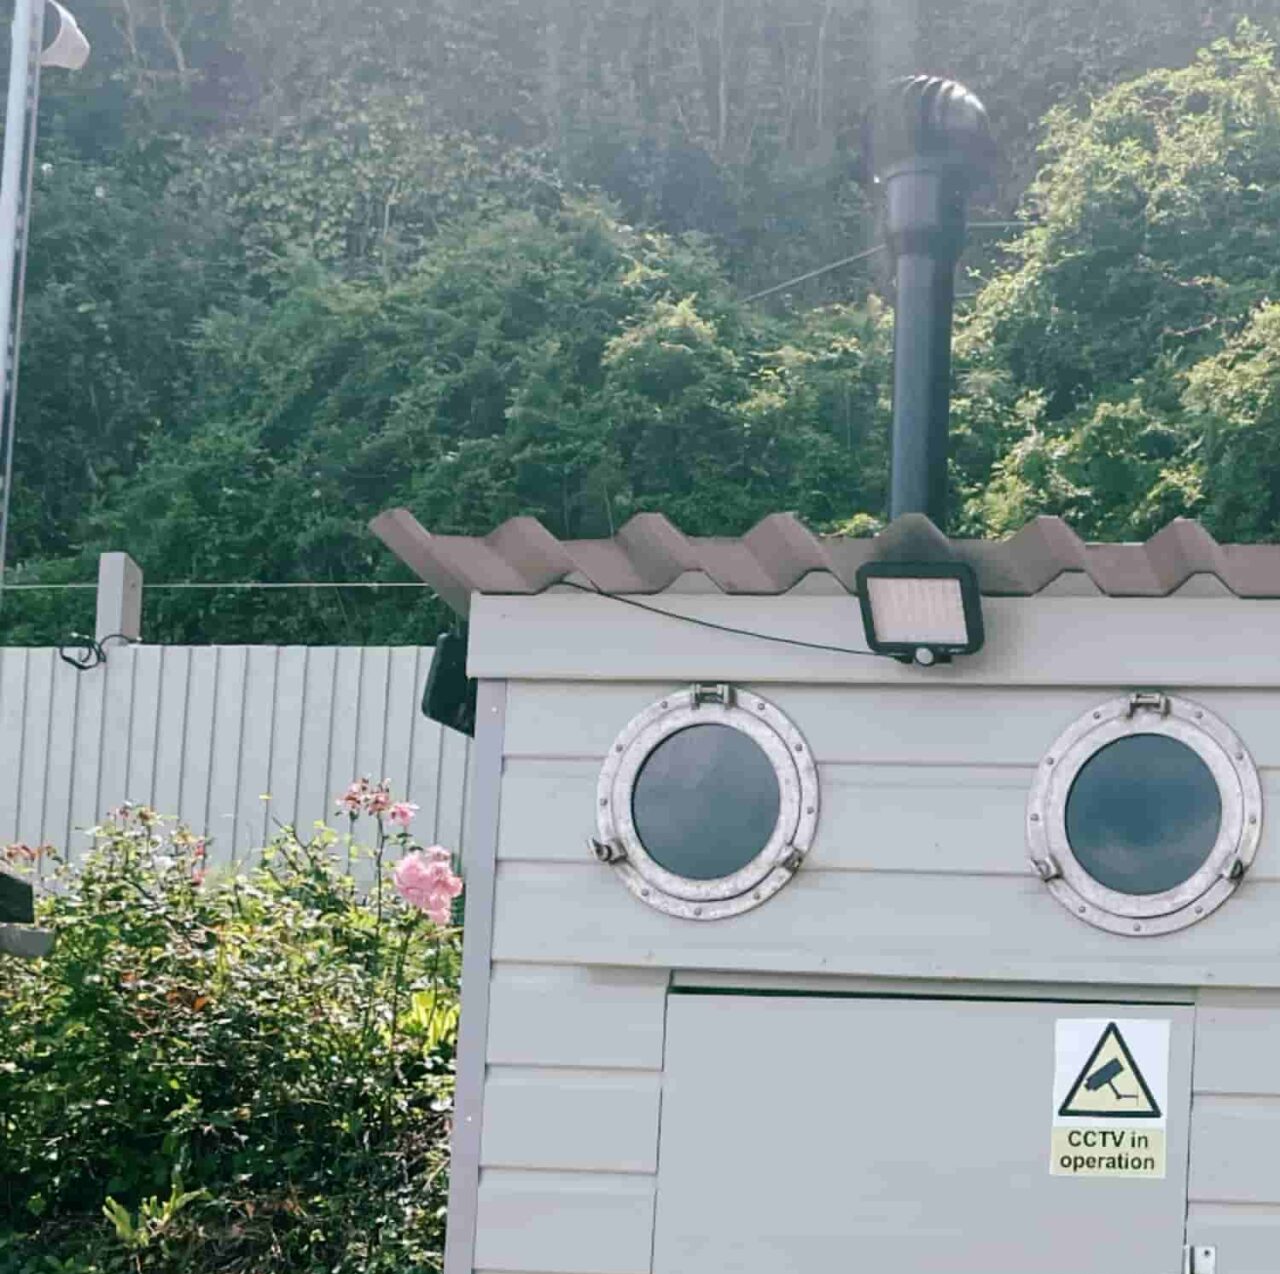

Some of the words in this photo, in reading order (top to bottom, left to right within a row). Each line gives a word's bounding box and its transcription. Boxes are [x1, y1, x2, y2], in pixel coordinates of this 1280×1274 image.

[1067, 1130, 1125, 1148] CCTV
[1130, 1130, 1149, 1149] in
[1059, 1153, 1155, 1172] operation
